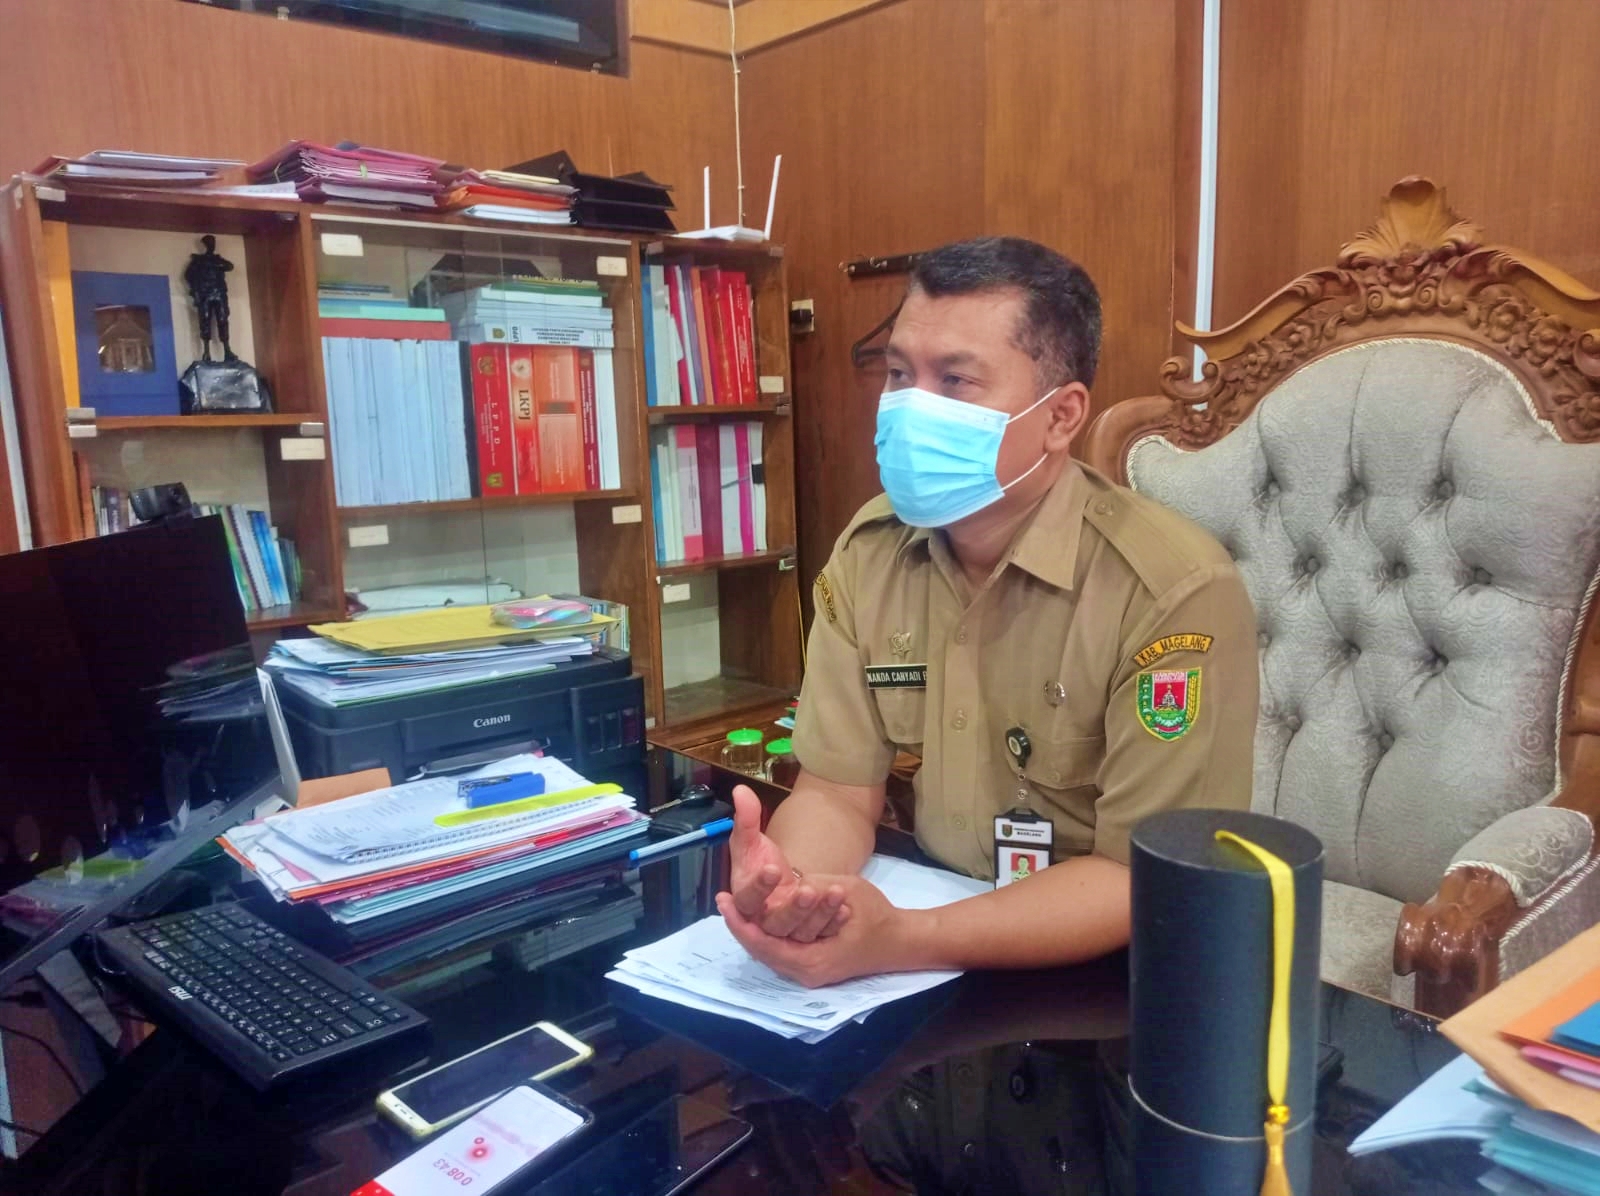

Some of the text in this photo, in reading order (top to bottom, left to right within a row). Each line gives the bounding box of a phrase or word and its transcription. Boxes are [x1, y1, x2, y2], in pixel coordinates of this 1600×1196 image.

[518, 389, 531, 421] LKPJ
[1160, 635, 1207, 651] MAGELANG
[867, 671, 891, 683] NANDA
[891, 671, 921, 682] CAHYADI
[473, 714, 511, 728] Canon
